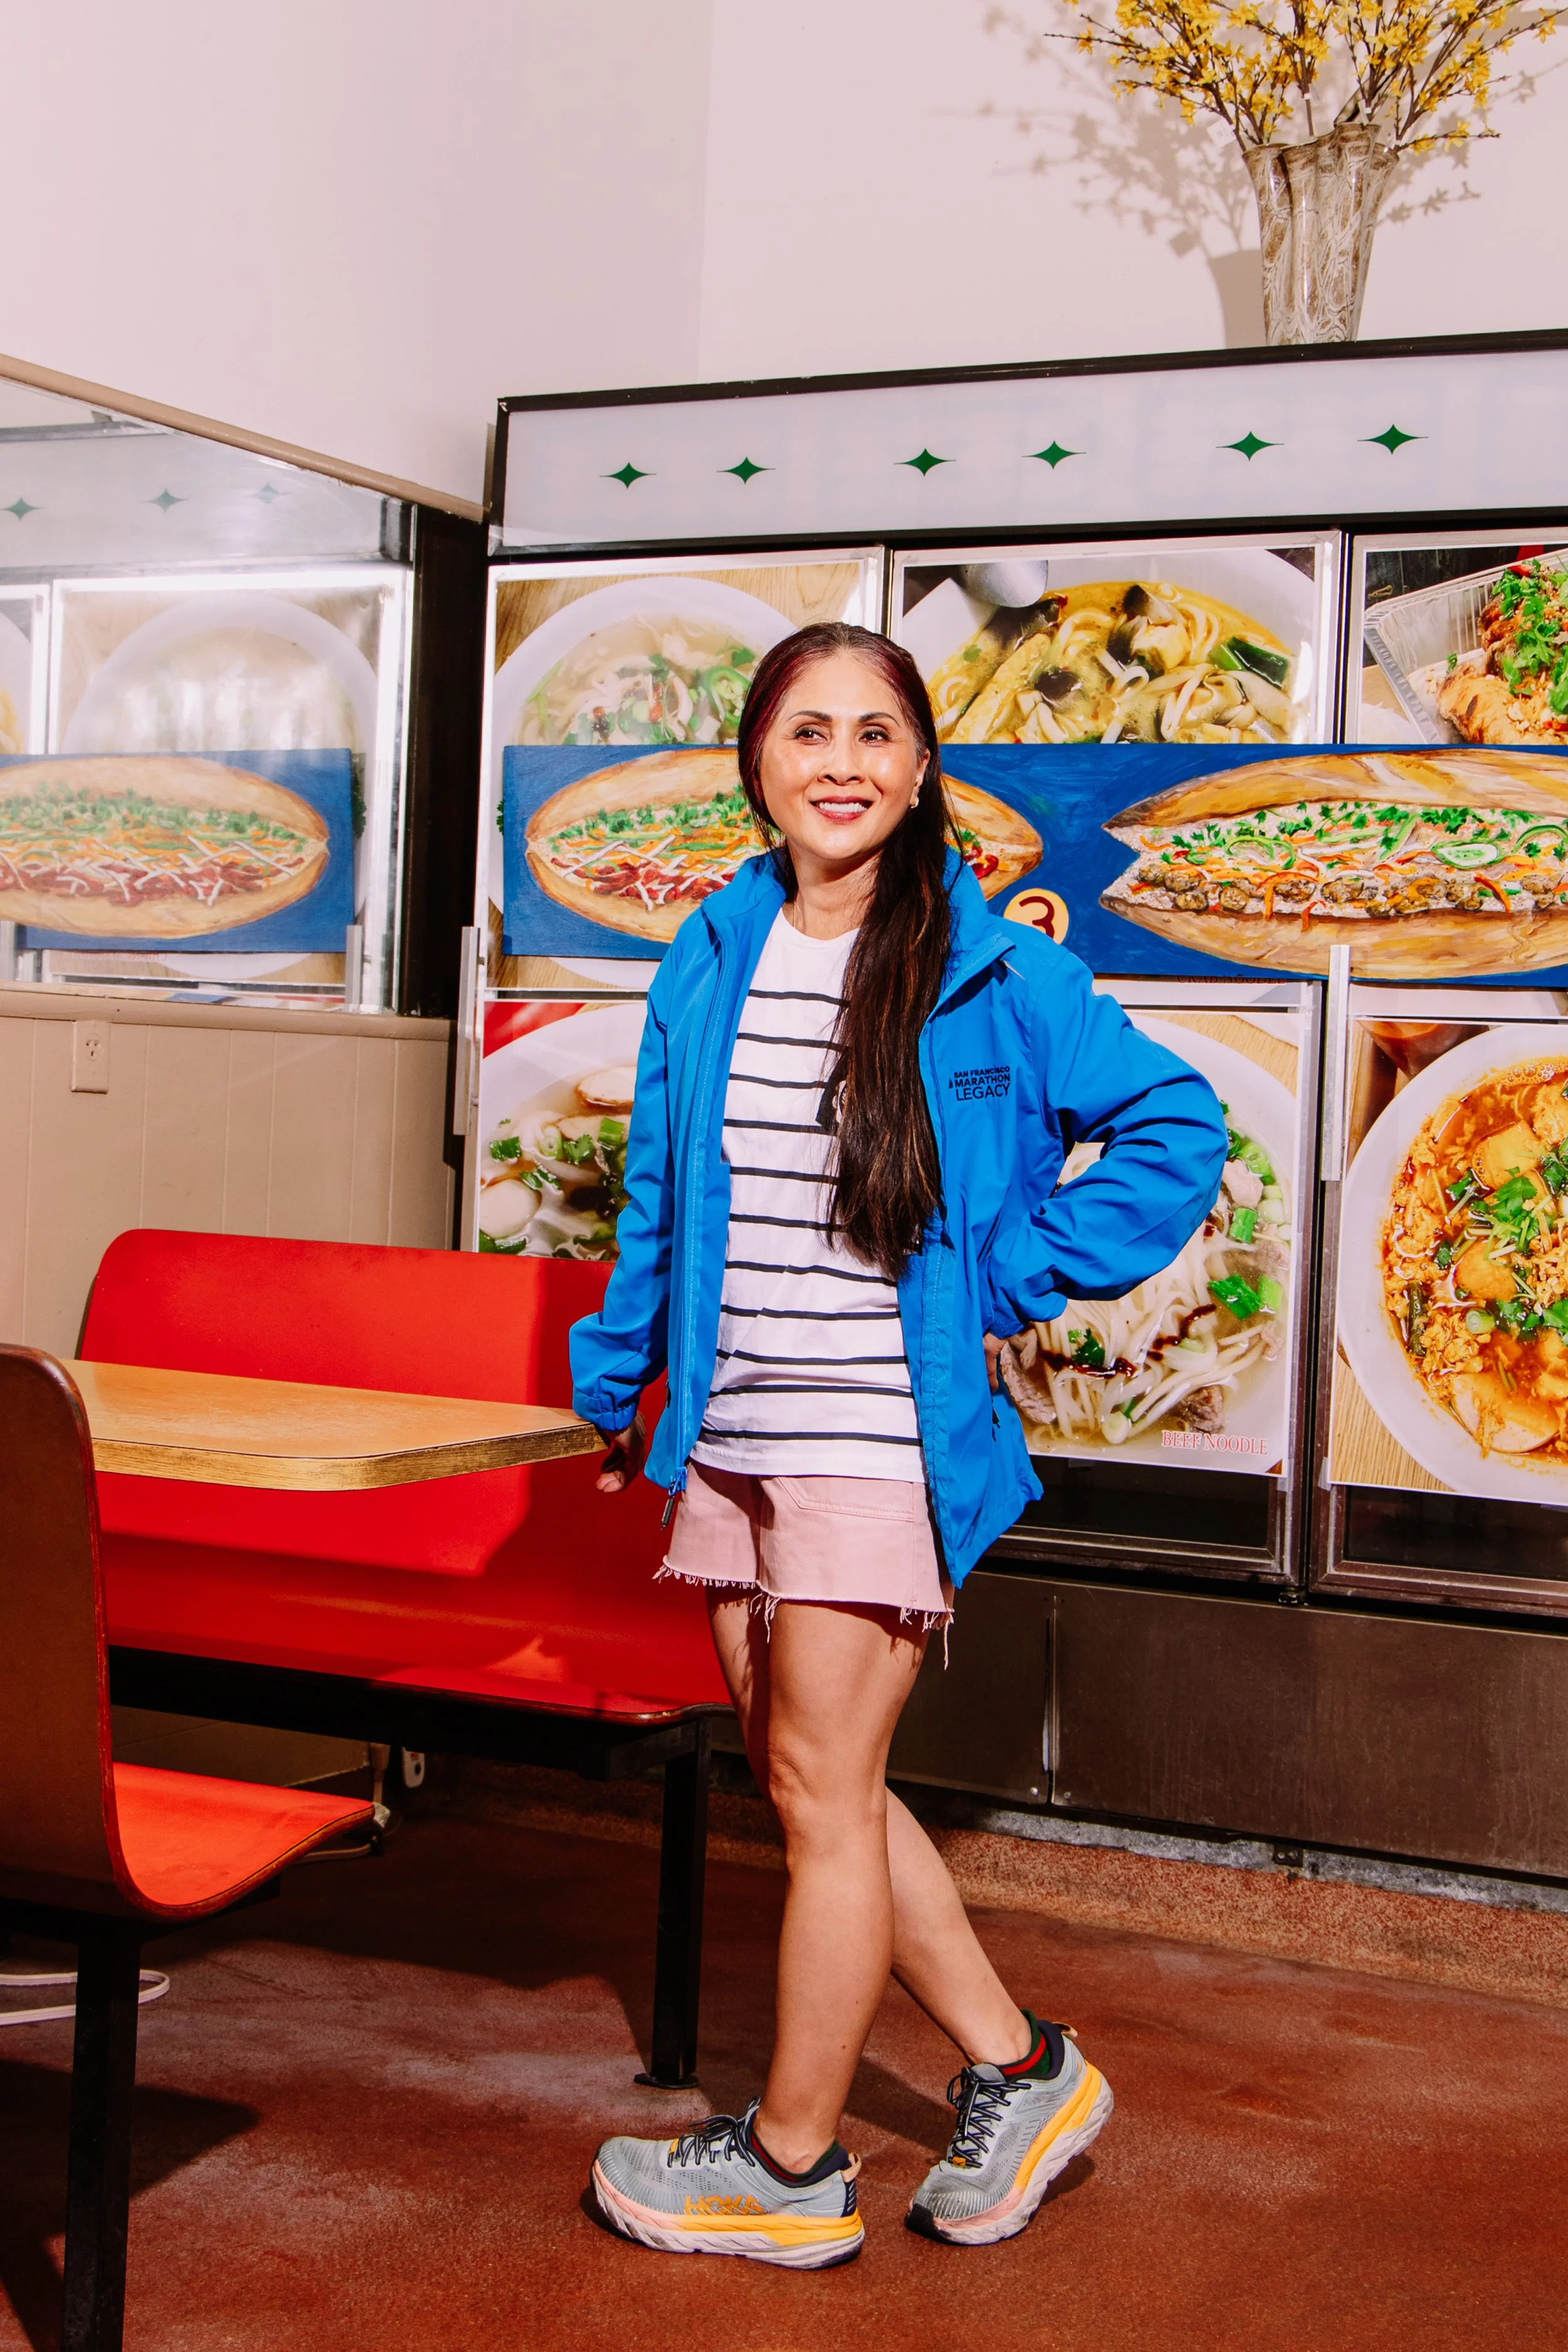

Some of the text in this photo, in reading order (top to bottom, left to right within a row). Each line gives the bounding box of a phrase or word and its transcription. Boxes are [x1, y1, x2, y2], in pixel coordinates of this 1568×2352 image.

[1019, 896, 1054, 939] 3
[954, 1066, 1010, 1079] SAN FRANCISCO
[955, 1073, 1010, 1088] MARATHON
[956, 1083, 1010, 1101] LEGACY
[1162, 1430, 1268, 1455] BEEF NOODLE
[684, 2194, 766, 2215] HOKA
